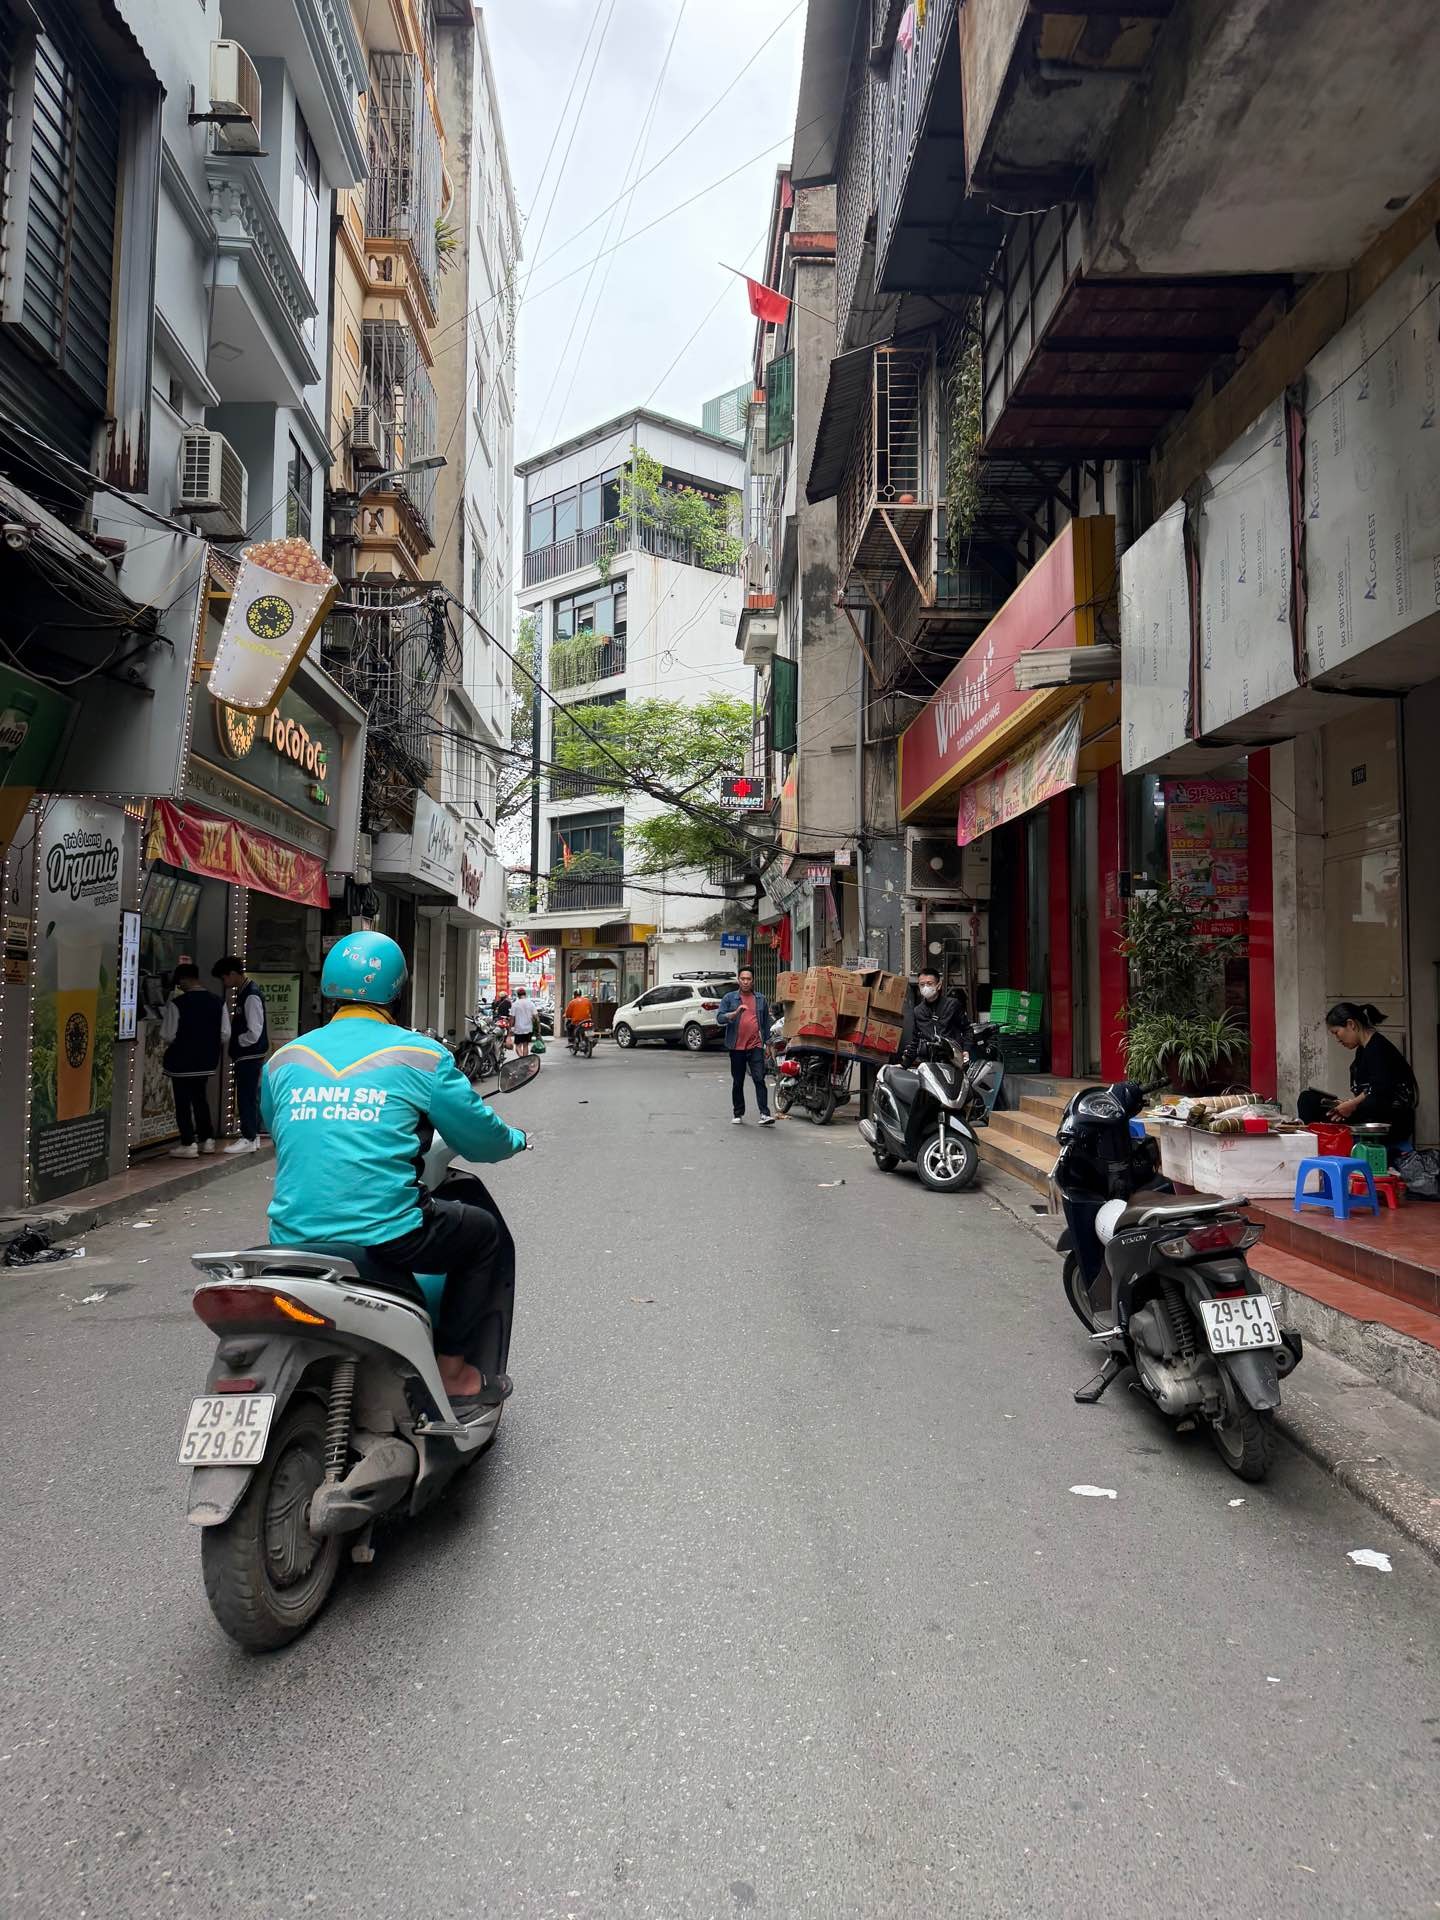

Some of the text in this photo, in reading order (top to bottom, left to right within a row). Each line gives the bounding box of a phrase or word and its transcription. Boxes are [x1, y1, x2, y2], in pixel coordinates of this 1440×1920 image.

[1308, 439, 1320, 520] ALCOREST
[1237, 512, 1248, 585] ALCOREST
[1363, 511, 1377, 600] ALCOREST
[1275, 546, 1288, 624] ALCOREST
[1203, 603, 1213, 670] ALCOREST
[63, 828, 102, 849] Trà Ô Long
[46, 838, 119, 901] Organic
[258, 983, 292, 993] ATCHA
[289, 1086, 388, 1107] XANH SM
[289, 1102, 382, 1123] xin chào!
[1121, 1234, 1148, 1246] VISION
[1211, 1297, 1263, 1325] 29-C1
[1212, 1321, 1276, 1349] 942.93
[197, 1398, 262, 1429] 29-AE
[183, 1430, 262, 1460] 529.67
